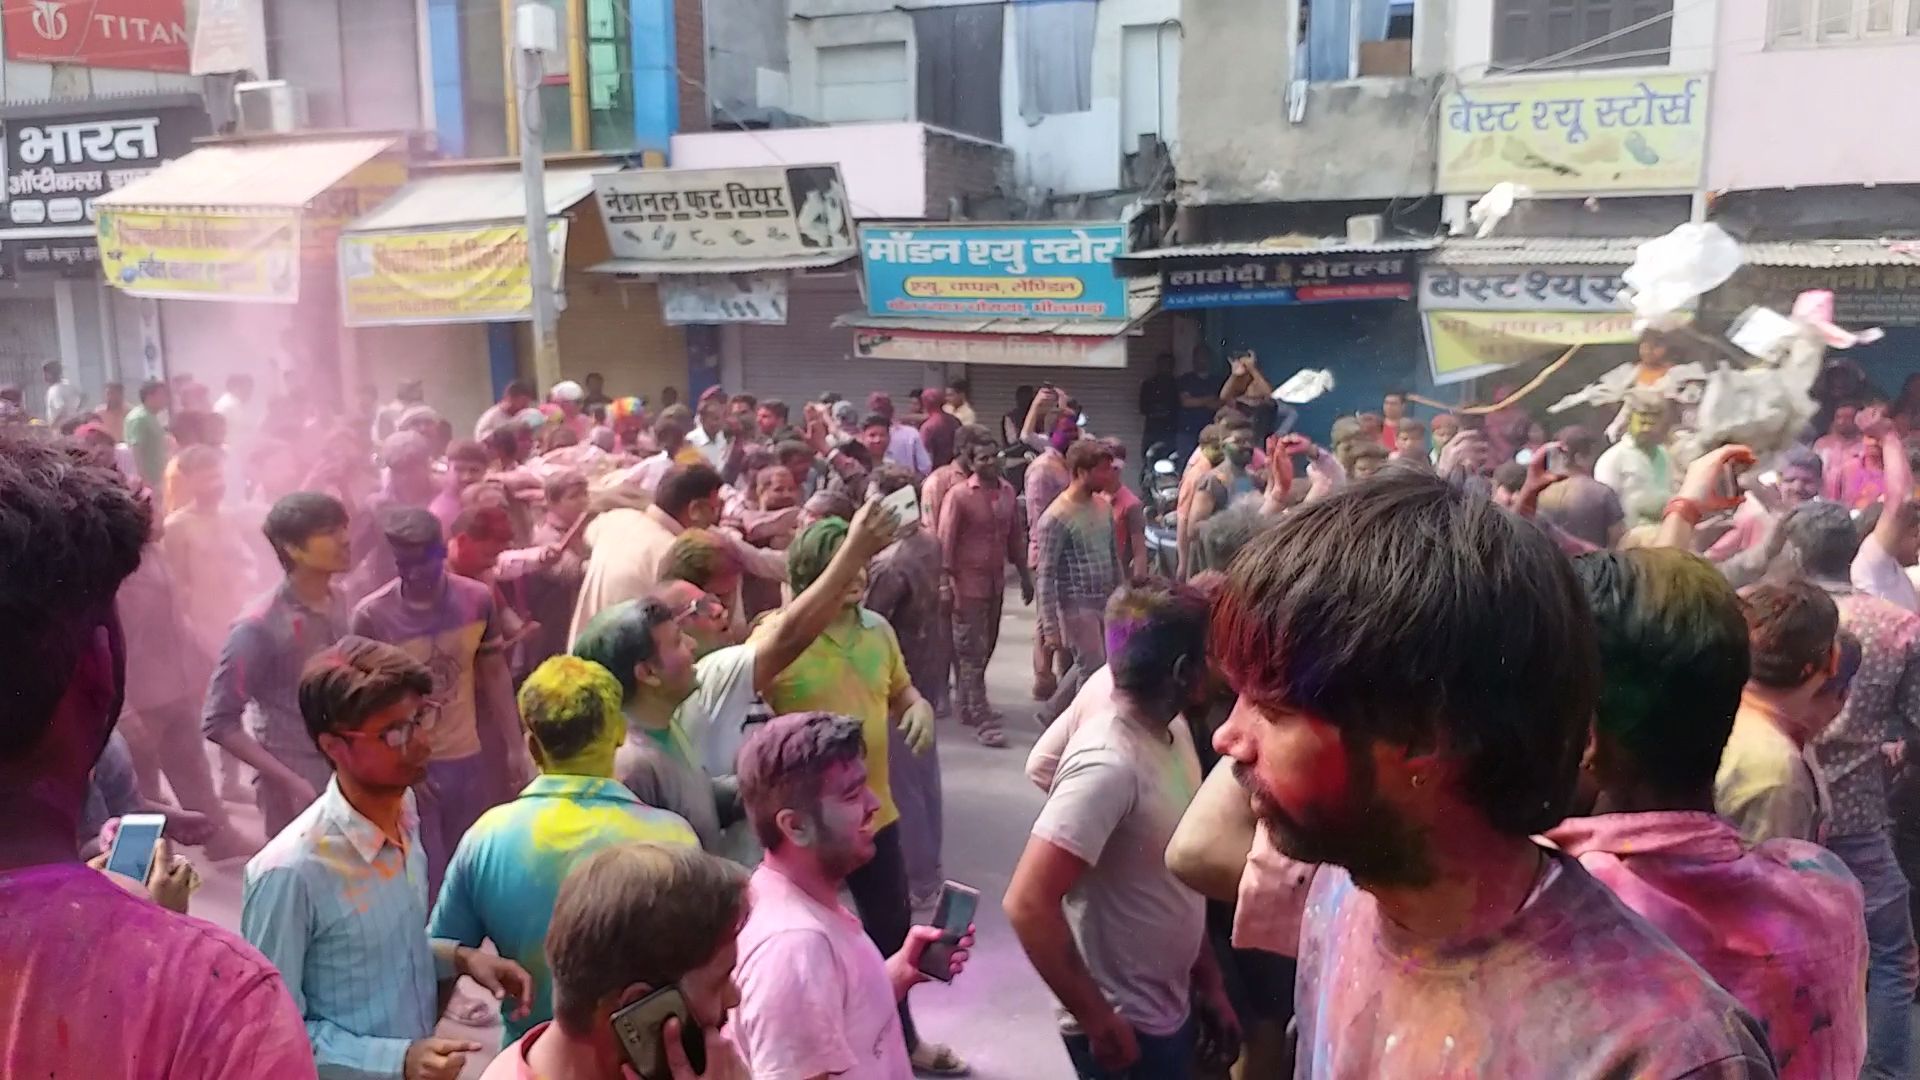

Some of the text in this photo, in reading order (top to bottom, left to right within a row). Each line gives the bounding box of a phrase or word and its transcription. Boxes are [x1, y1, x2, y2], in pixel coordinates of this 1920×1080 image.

[94, 14, 188, 45] TITAN
[1448, 80, 1701, 143] बेस्ट श्यू स्टोर्स
[19, 117, 160, 164] भारत
[684, 190, 723, 218] फुट
[726, 183, 783, 208] वियर
[1029, 230, 1121, 264] स्टोर
